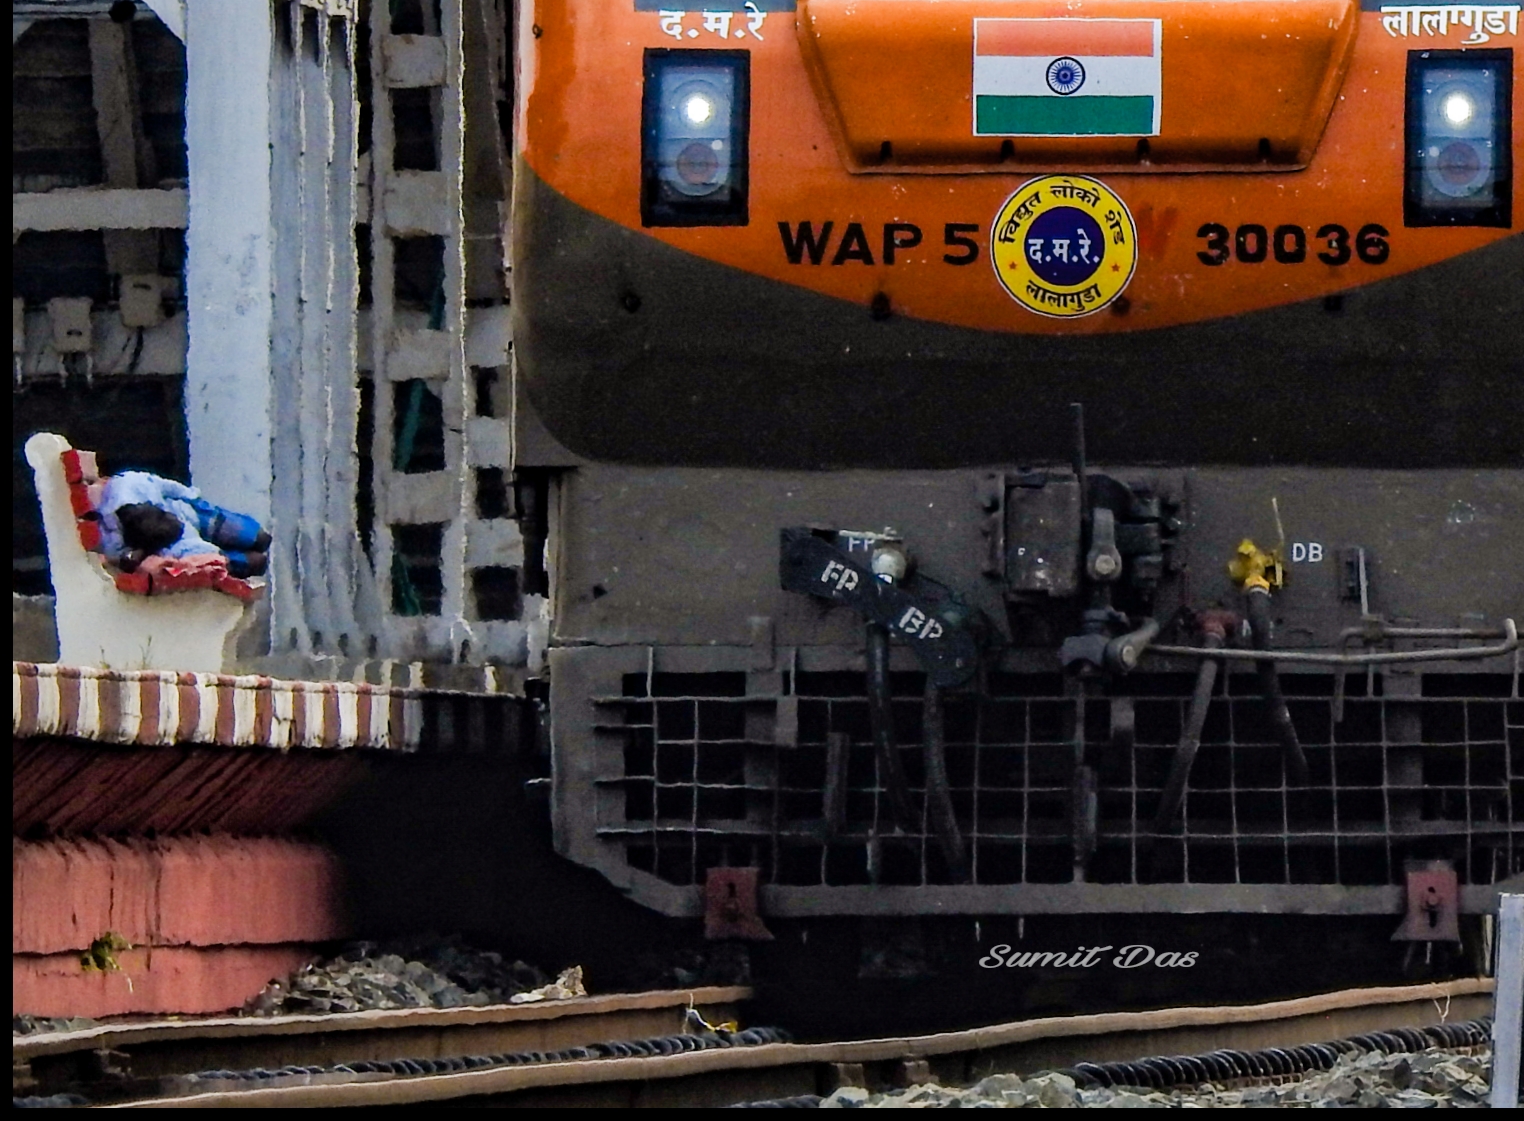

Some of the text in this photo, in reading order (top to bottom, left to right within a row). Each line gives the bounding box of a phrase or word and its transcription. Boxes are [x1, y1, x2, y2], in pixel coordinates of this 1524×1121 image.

[659, 0, 768, 41] द.म.रे
[999, 191, 1042, 244] विद्युत
[1050, 180, 1101, 207] लोको
[777, 221, 980, 265] WAP 5
[1196, 222, 1391, 266] 30036
[1026, 280, 1102, 311] लालागुडा
[1292, 542, 1323, 562] DB
[820, 560, 859, 591] FP
[899, 606, 944, 639] BP
